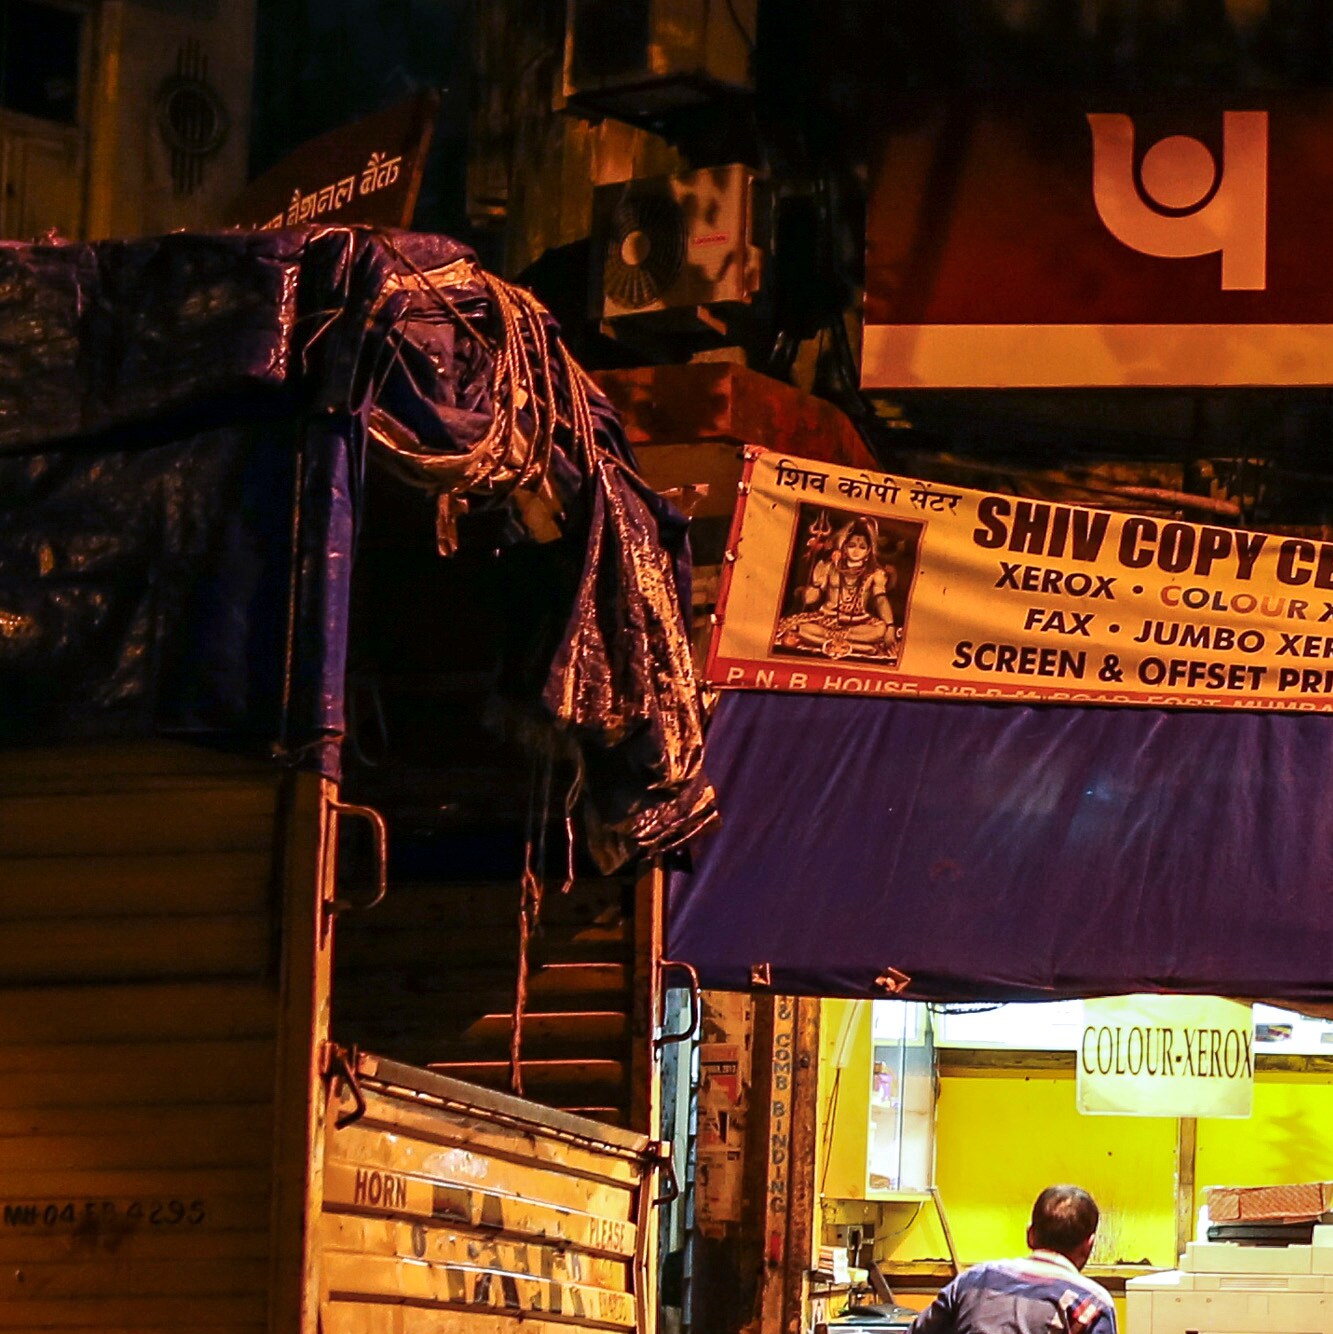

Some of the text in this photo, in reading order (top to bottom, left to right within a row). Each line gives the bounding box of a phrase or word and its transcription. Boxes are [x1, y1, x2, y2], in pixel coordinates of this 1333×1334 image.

[775, 459, 962, 516] शिव कोपी सेंटर
[973, 496, 1111, 563] SHIV
[1118, 517, 1268, 580] COPY
[994, 561, 1117, 600] XEROX
[1161, 585, 1308, 620] COLOUR
[1024, 608, 1095, 636] FAX
[1134, 620, 1265, 653] JUMBO
[951, 641, 1086, 679] SCREEN
[1098, 654, 1124, 683] &
[1138, 657, 1267, 691] OFFSET
[769, 1101, 790, 1213] BINDING
[354, 1168, 407, 1208] HORN
[589, 1216, 626, 1254] PLEASE
